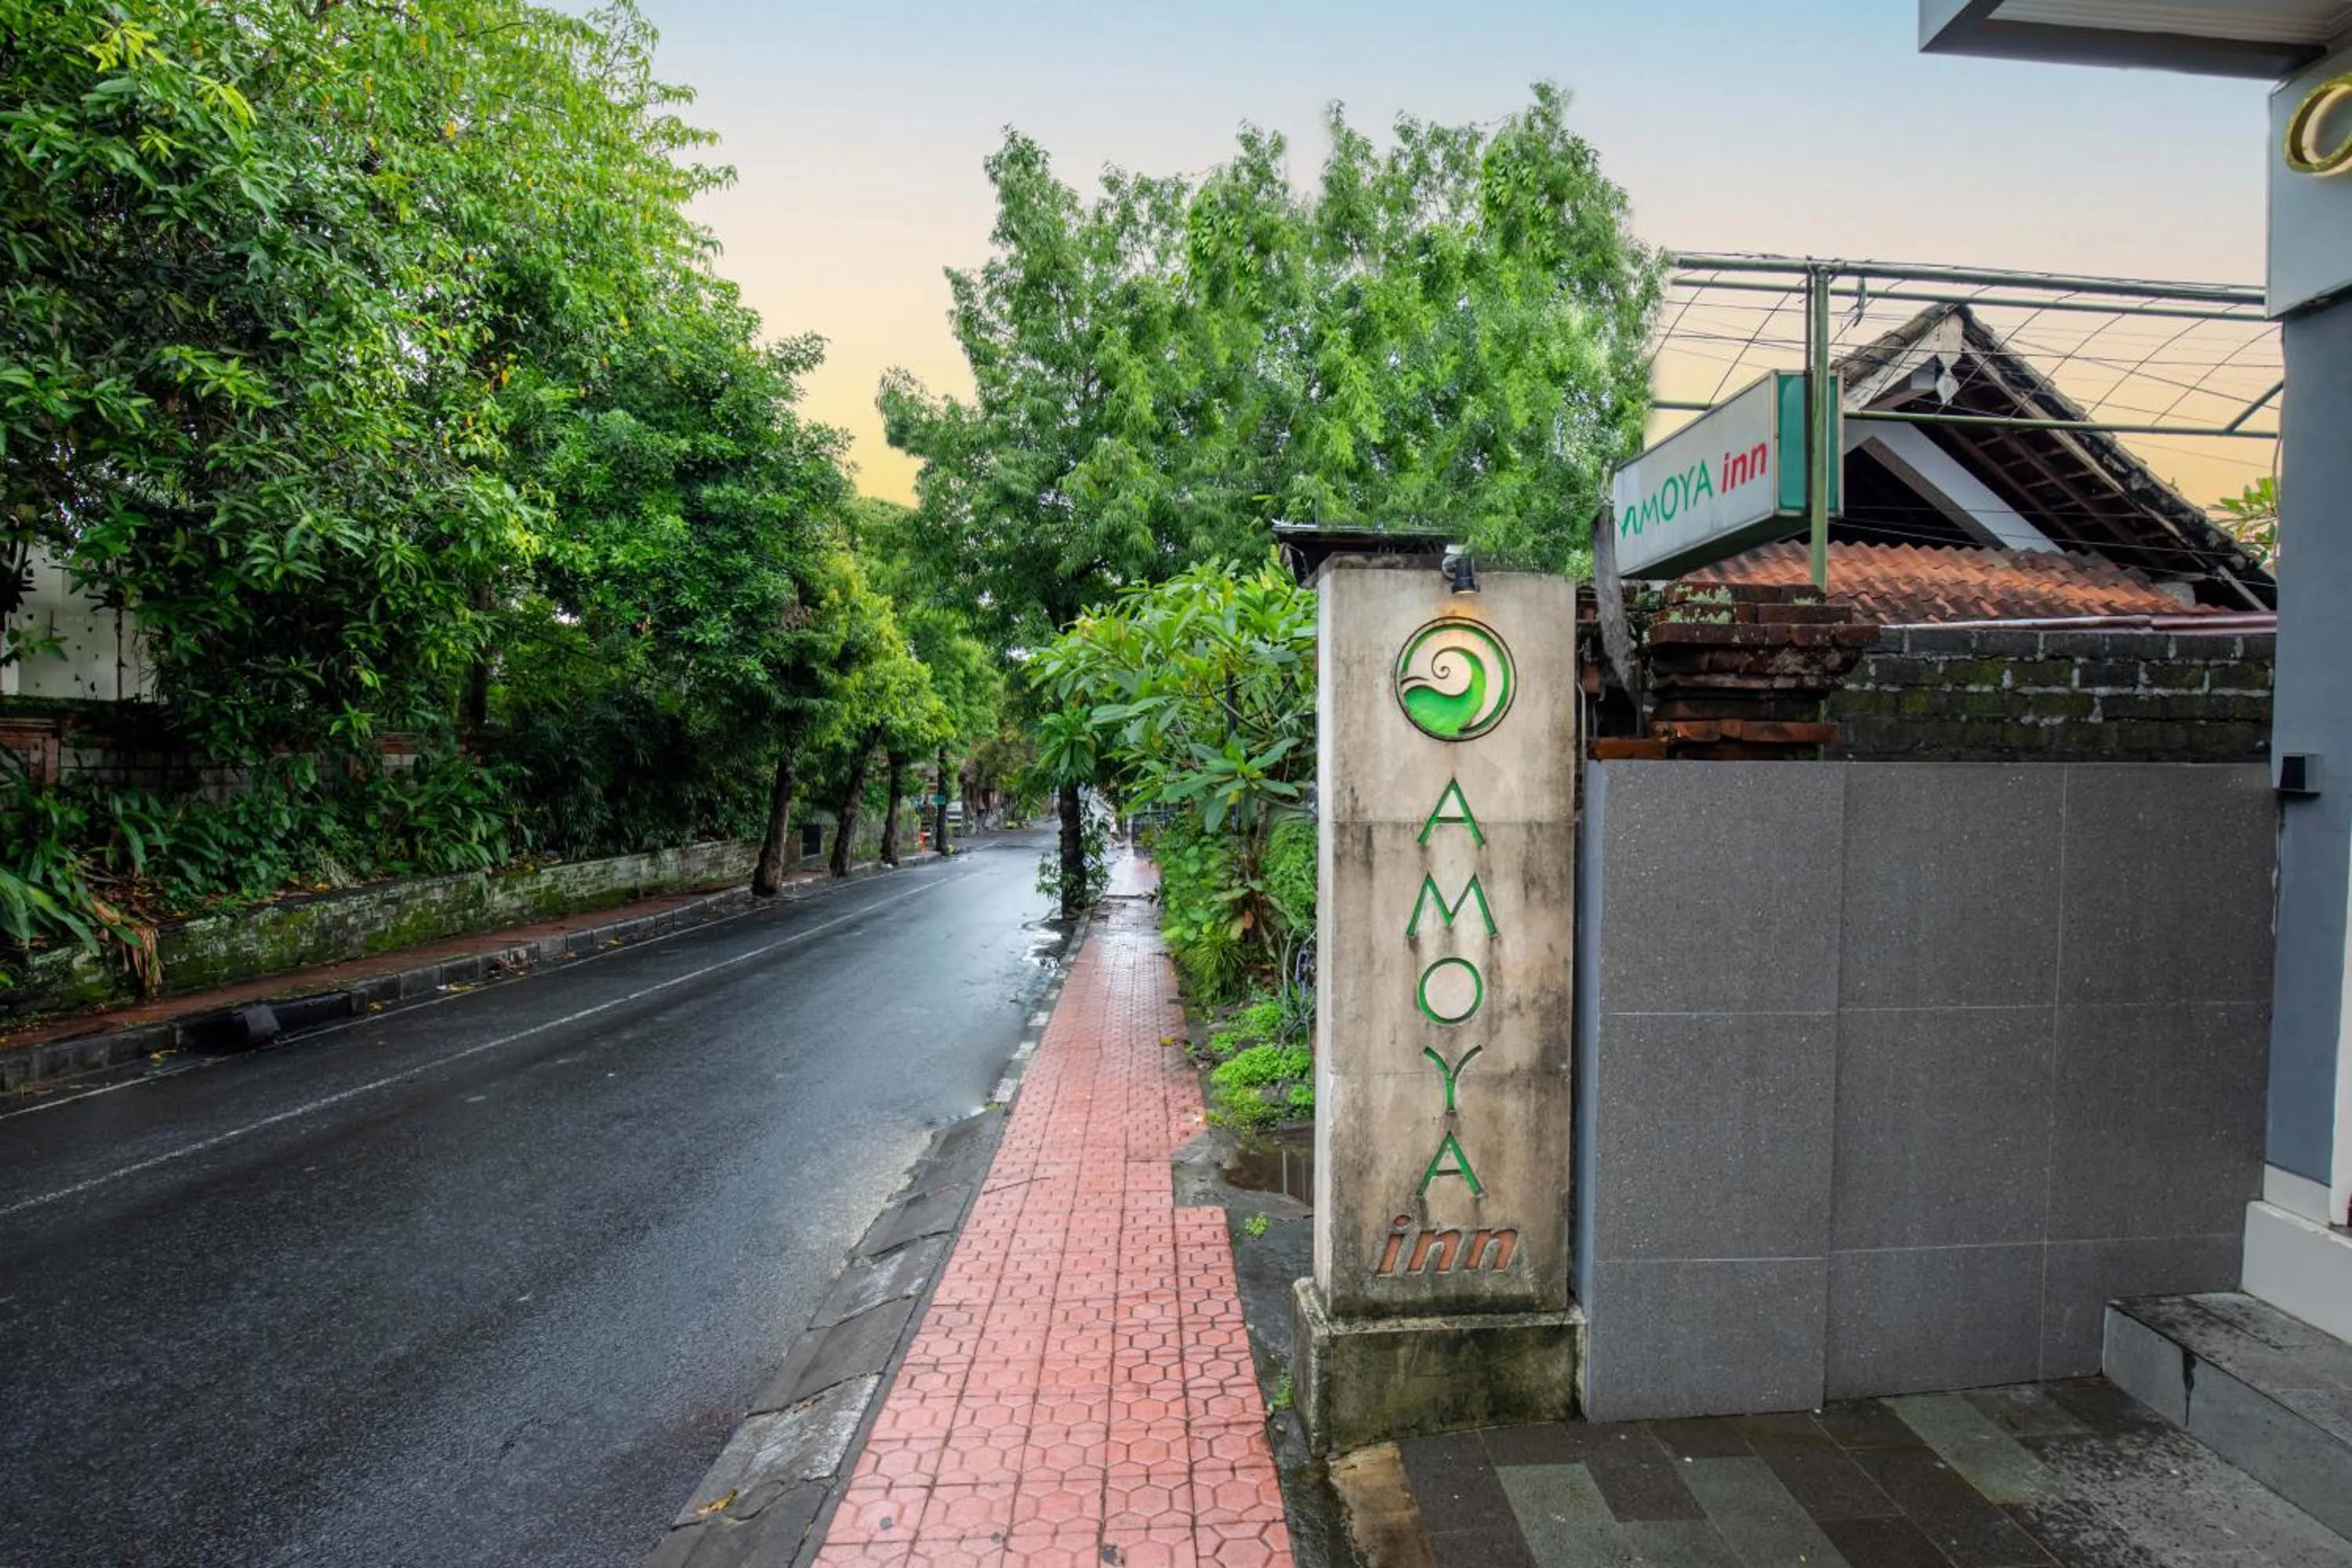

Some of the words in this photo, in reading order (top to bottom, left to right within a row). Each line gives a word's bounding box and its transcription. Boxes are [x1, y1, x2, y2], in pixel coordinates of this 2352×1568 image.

[1721, 441, 1769, 495] inn
[1405, 775, 1499, 1200] AMOYA
[1376, 1214, 1519, 1276] inn
